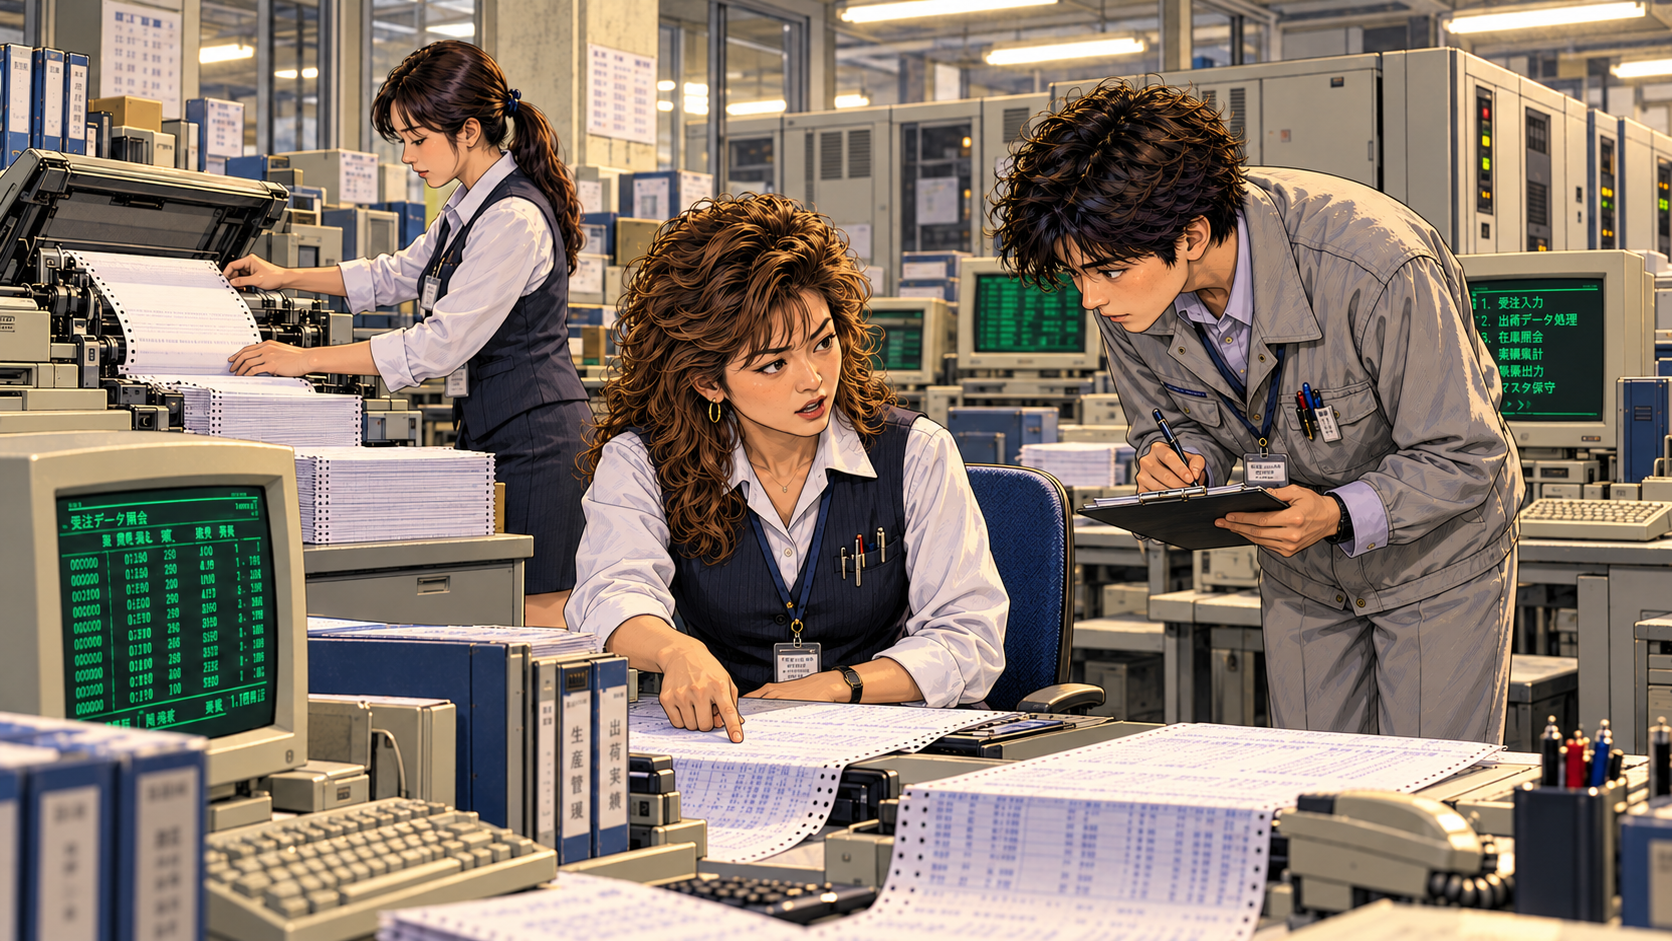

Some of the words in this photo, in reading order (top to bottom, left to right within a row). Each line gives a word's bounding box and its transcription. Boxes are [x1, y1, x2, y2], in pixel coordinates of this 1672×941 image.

[1482, 298, 1490, 309] 1.
[1498, 296, 1544, 309] 受注入力
